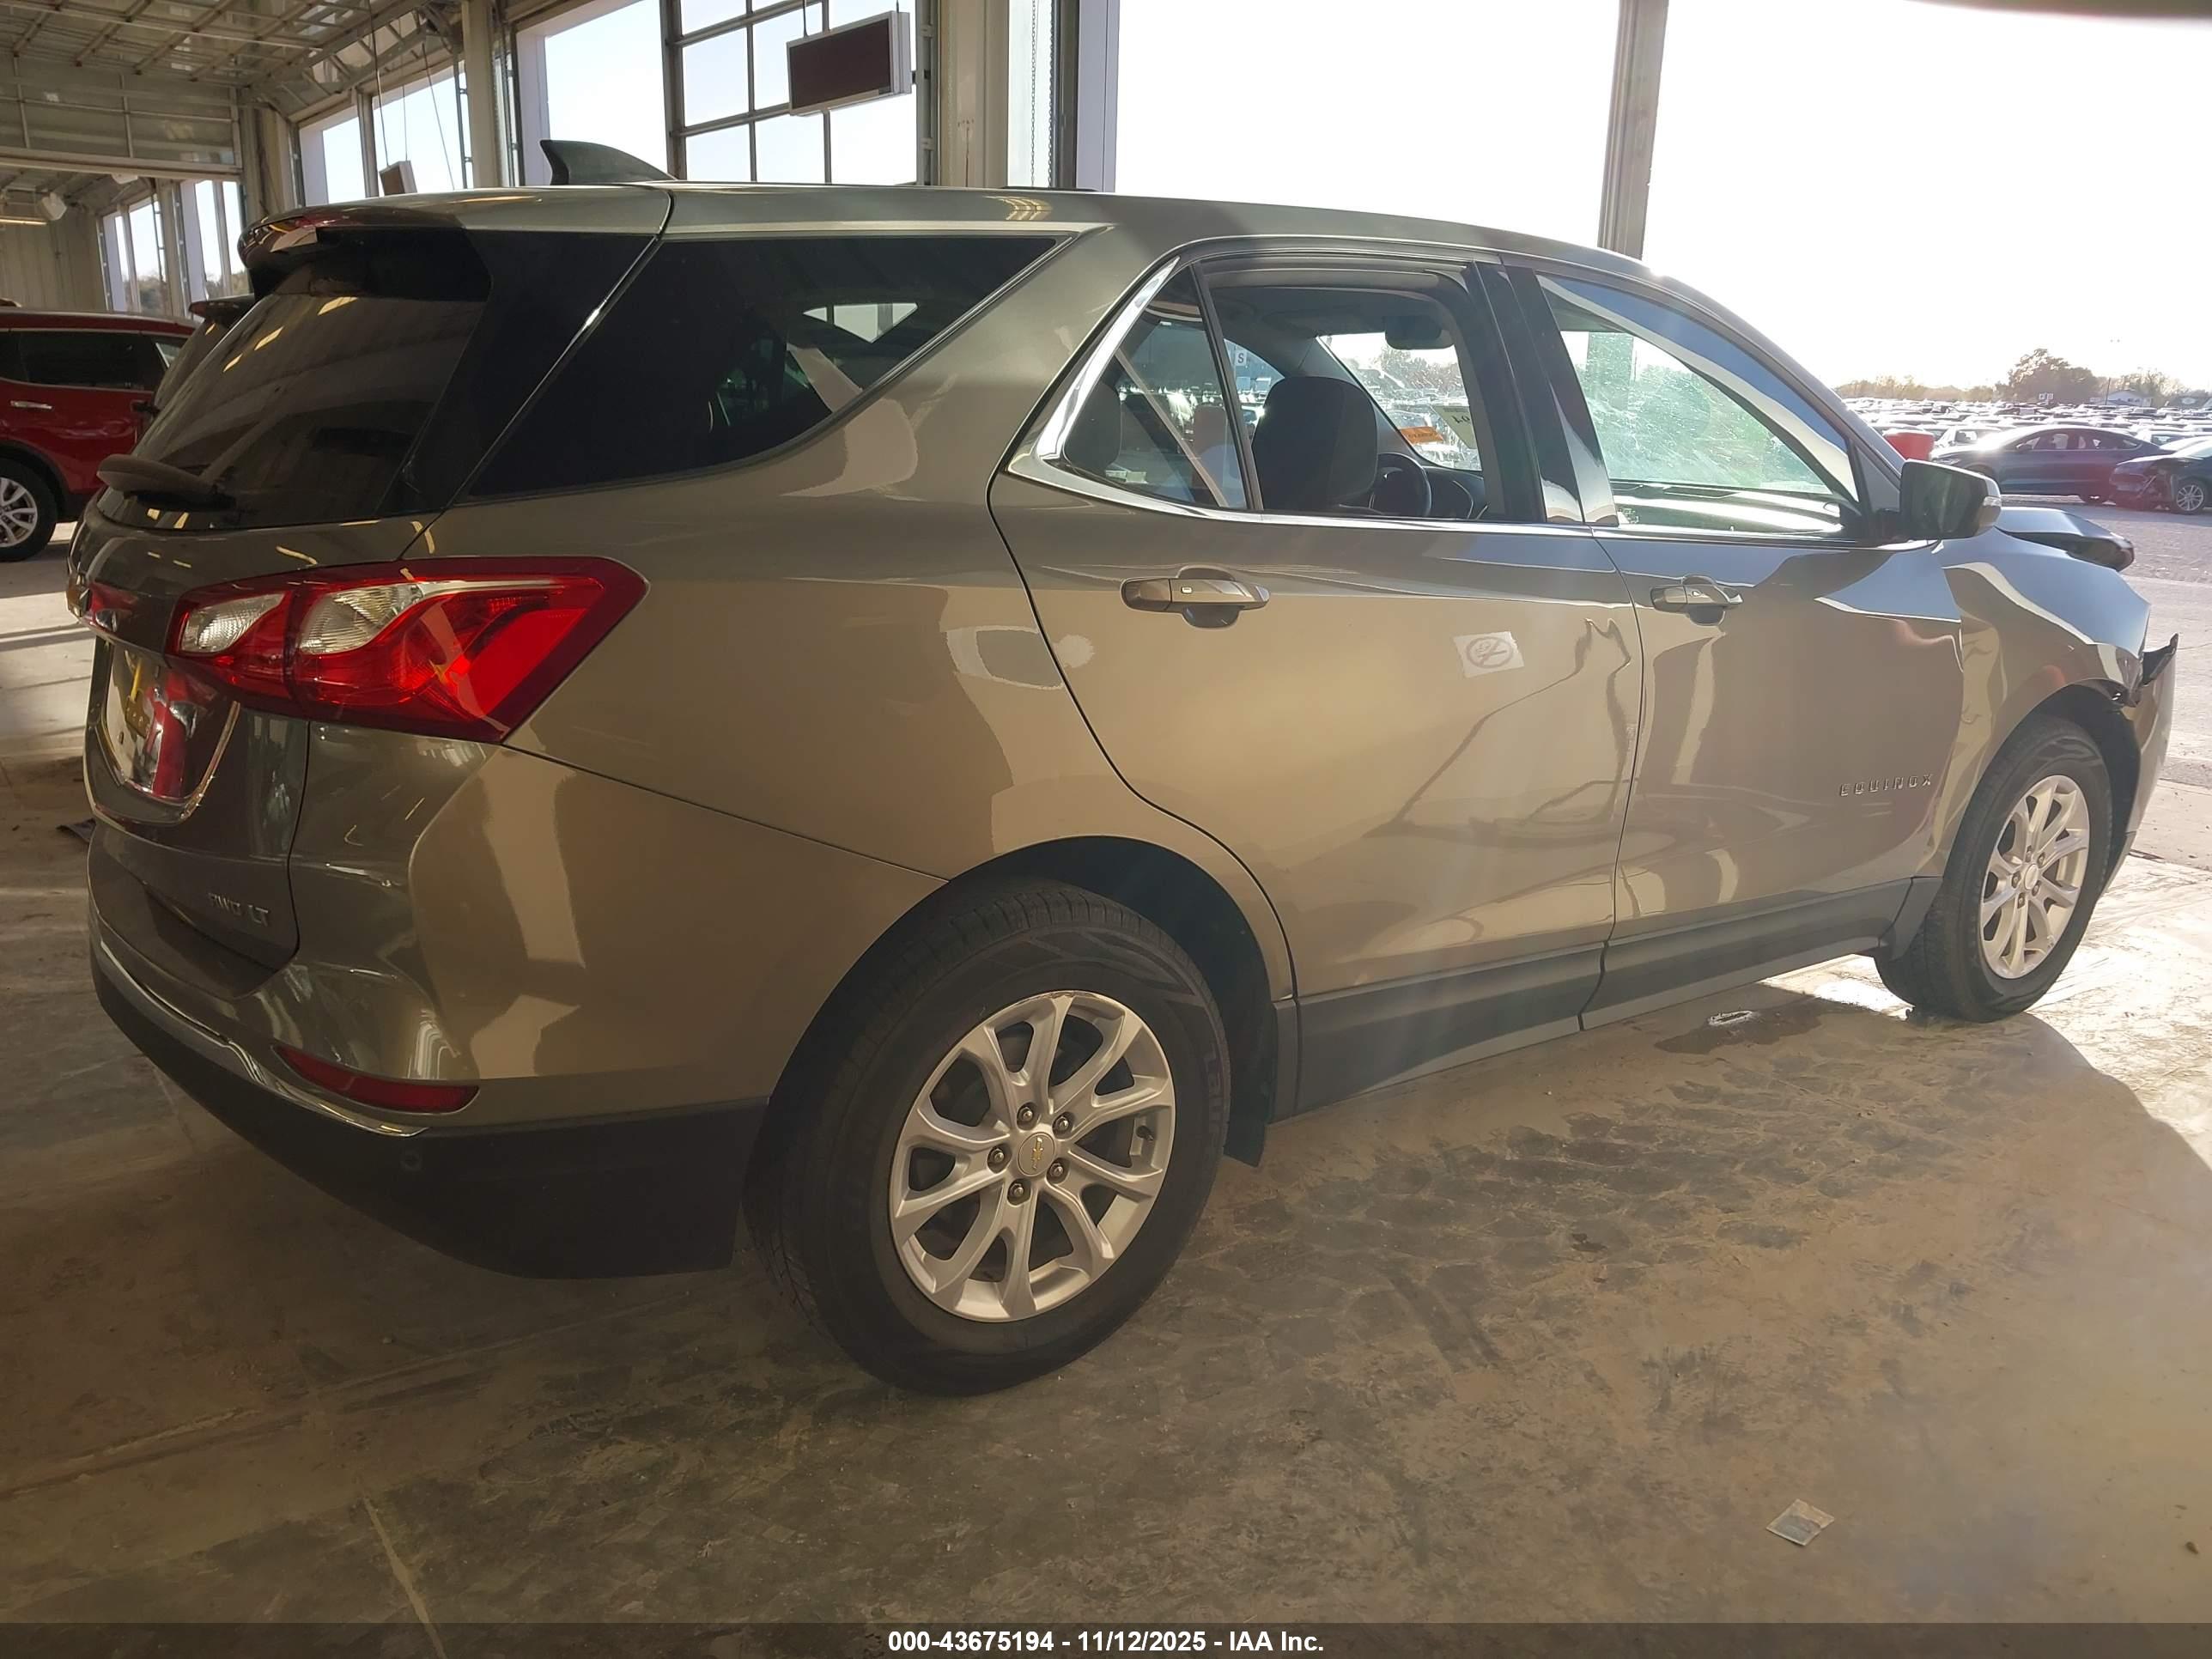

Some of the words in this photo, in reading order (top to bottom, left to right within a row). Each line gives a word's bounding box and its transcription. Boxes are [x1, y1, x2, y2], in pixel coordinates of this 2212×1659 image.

[1237, 352, 1244, 363] S
[1839, 774, 1933, 797] EQUINOX
[247, 904, 269, 927] LT
